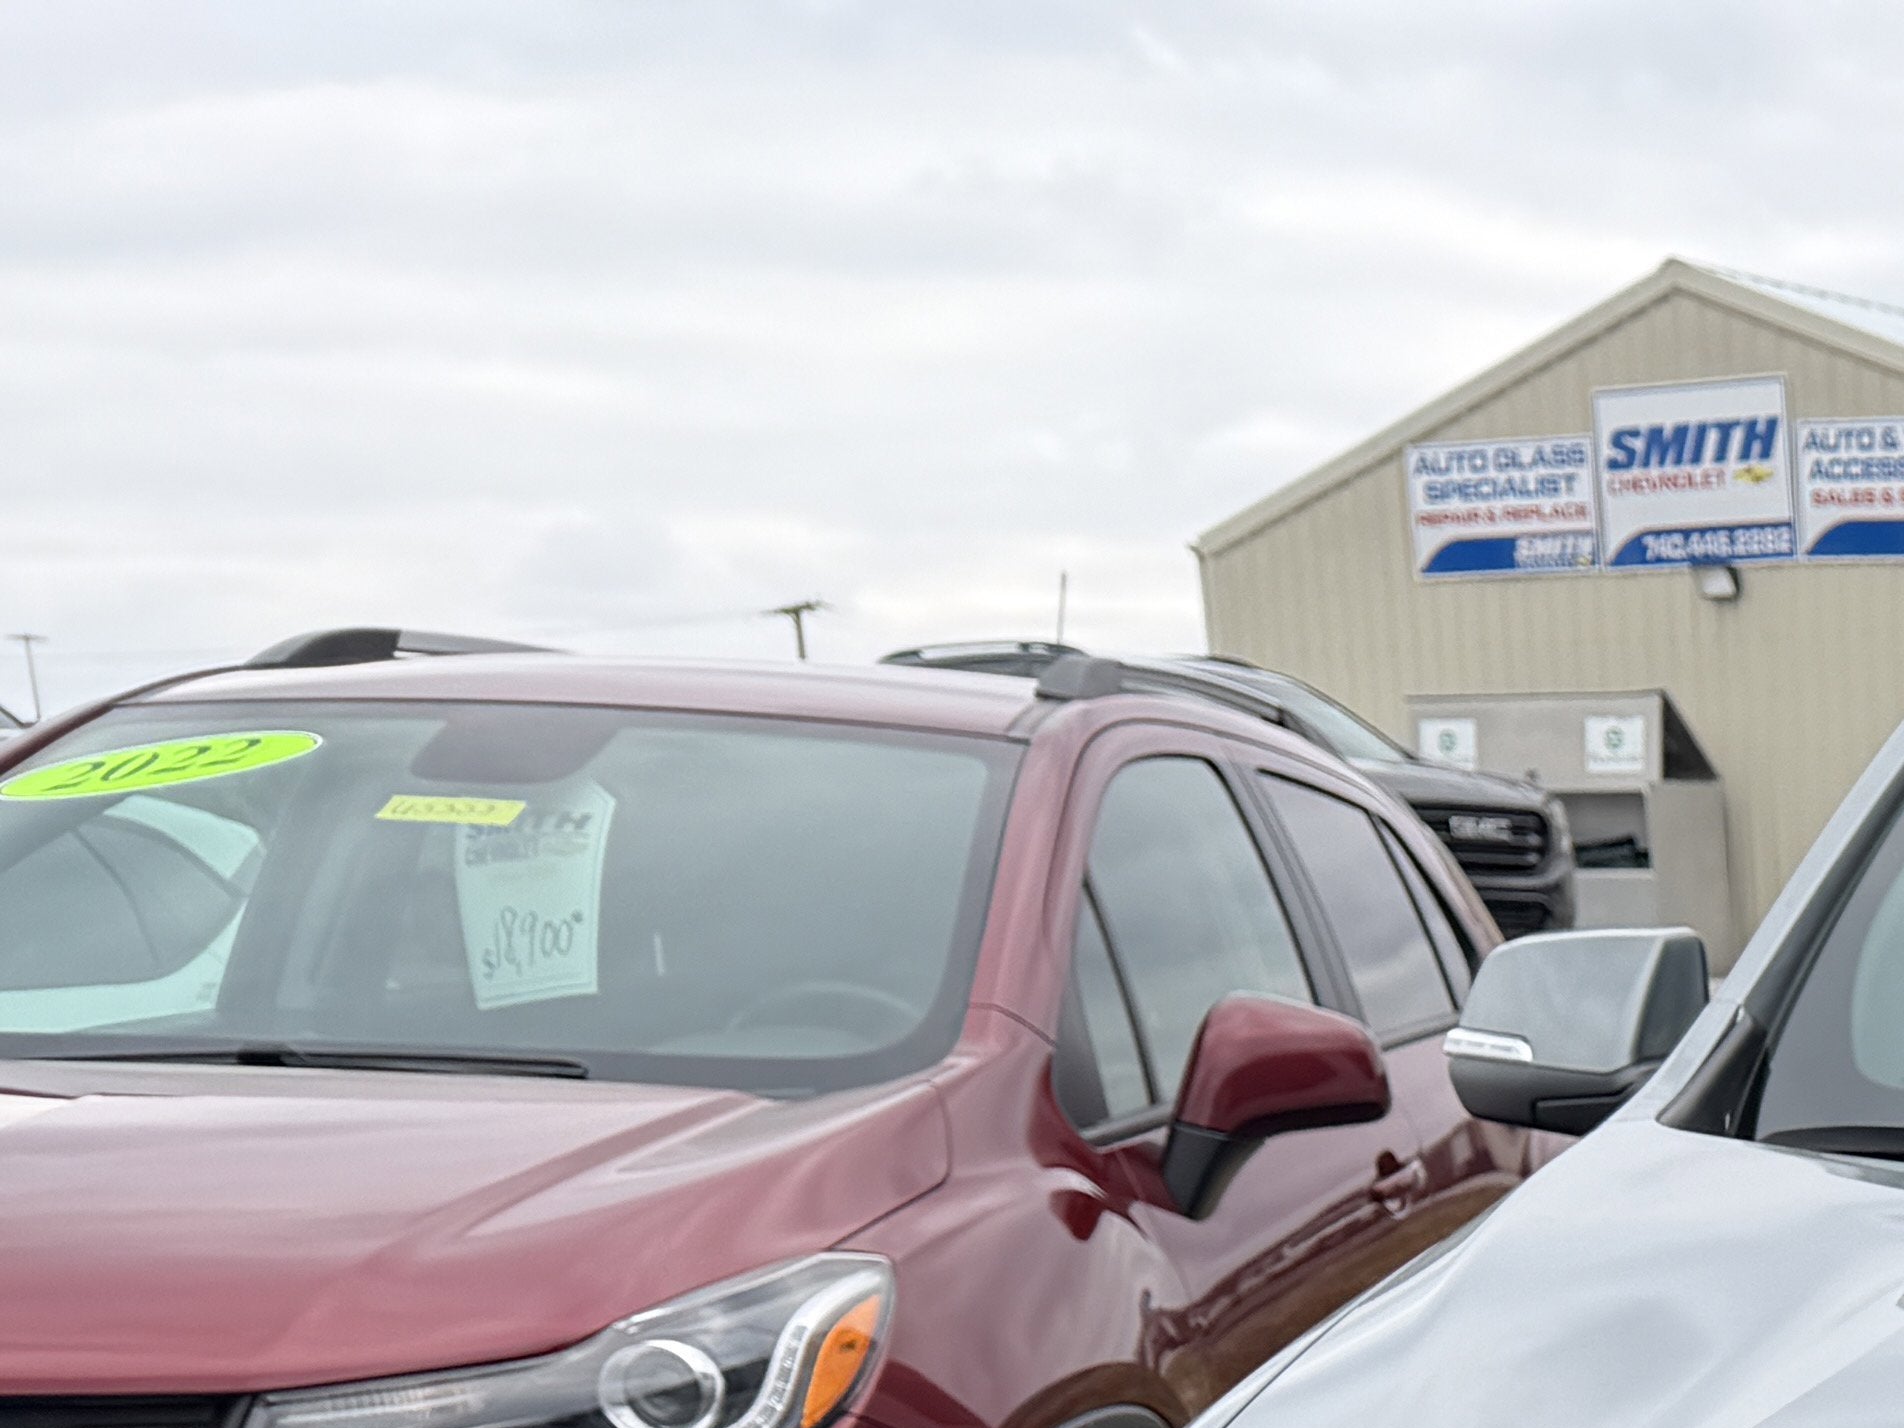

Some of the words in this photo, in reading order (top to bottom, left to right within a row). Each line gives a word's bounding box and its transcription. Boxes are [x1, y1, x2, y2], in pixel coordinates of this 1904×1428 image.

[1607, 416, 1778, 470] SMITH
[1805, 426, 1876, 452] AUTO
[1881, 426, 1898, 448] &
[1414, 450, 1489, 475] AUTO
[1493, 443, 1586, 472] GLASS
[1424, 473, 1578, 503] SPECIALIST
[1607, 468, 1726, 496] CHEVROLET
[1811, 487, 1876, 508] SALES
[1881, 487, 1894, 507] &
[1515, 534, 1593, 557] SMITH
[41, 738, 262, 792] 2022
